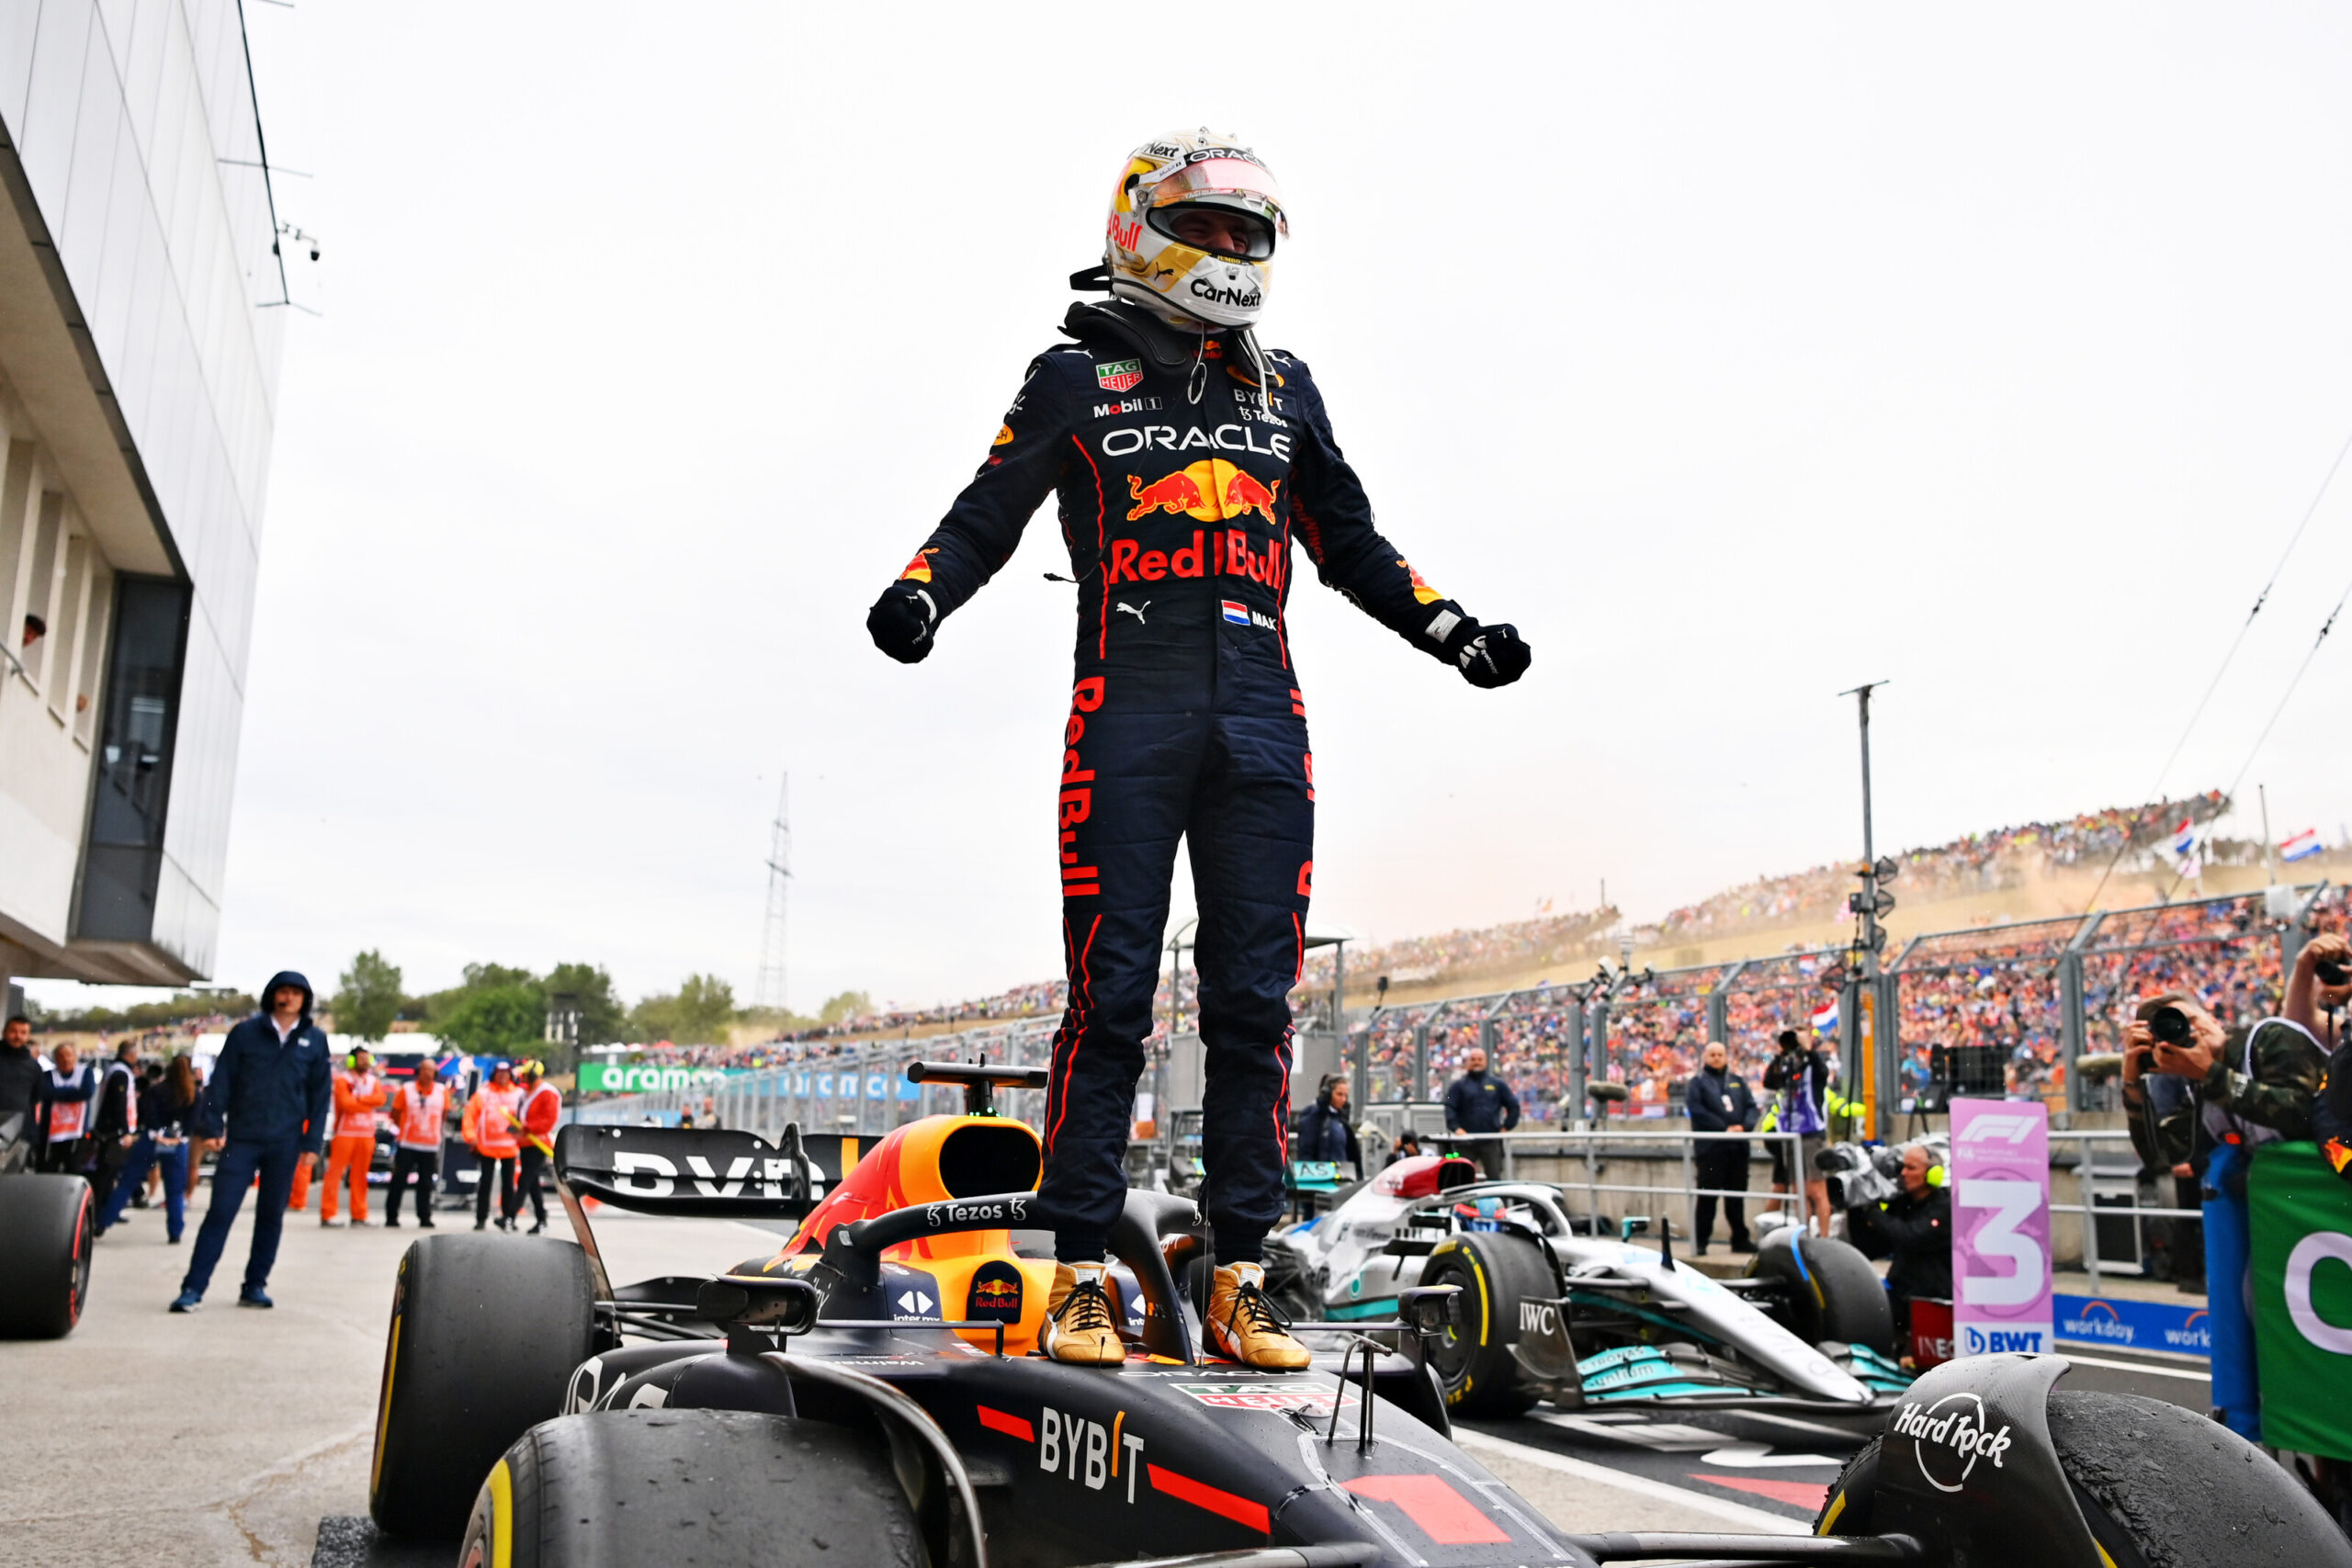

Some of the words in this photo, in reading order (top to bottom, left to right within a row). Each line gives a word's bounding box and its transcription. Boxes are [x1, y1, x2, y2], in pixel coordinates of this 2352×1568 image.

[1191, 278, 1261, 307] CarNext
[1100, 361, 1137, 375] TAG
[1102, 372, 1141, 391] HEUER
[1093, 398, 1143, 418] Mobil
[1102, 423, 1291, 464] ORACLE
[1109, 529, 1204, 584] Red
[1214, 528, 1283, 591] Bull
[1252, 611, 1277, 631] MAX
[1061, 676, 1105, 785] Red
[1058, 787, 1101, 897] Bull
[946, 1203, 1003, 1223] Tezos
[1958, 1179, 2044, 1305] 3
[975, 1296, 997, 1308] Red
[998, 1297, 1018, 1309] Bull
[1519, 1302, 1555, 1336] IWC
[2063, 1319, 2134, 1344] workday
[1990, 1332, 2042, 1353] BWT
[1188, 1384, 1325, 1393] TAG
[1894, 1402, 1959, 1444] Hard
[1950, 1416, 2012, 1468] Rock
[1040, 1406, 1145, 1505] BYBIT
[1337, 1473, 1513, 1545] 1
